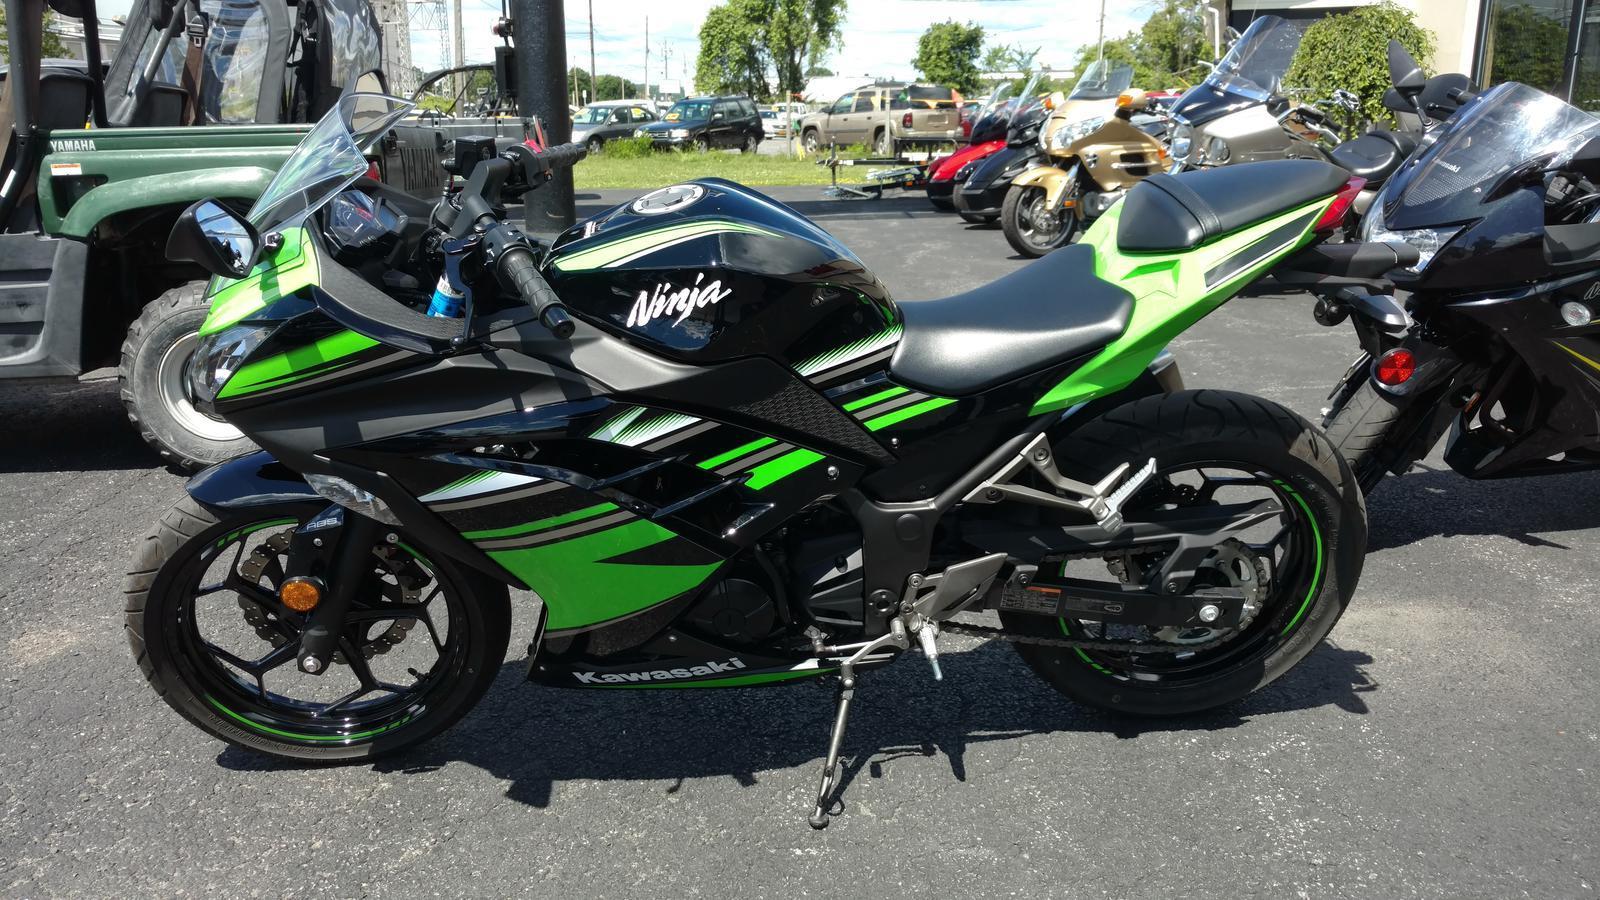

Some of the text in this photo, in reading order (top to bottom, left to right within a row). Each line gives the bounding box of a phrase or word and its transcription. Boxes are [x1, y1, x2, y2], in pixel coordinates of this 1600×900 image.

[50, 139, 96, 152] YAMAHA
[399, 147, 440, 191] YAMAHA
[626, 272, 733, 329] Ninja
[306, 517, 338, 531] ABS
[572, 656, 747, 684] Kawasaki
